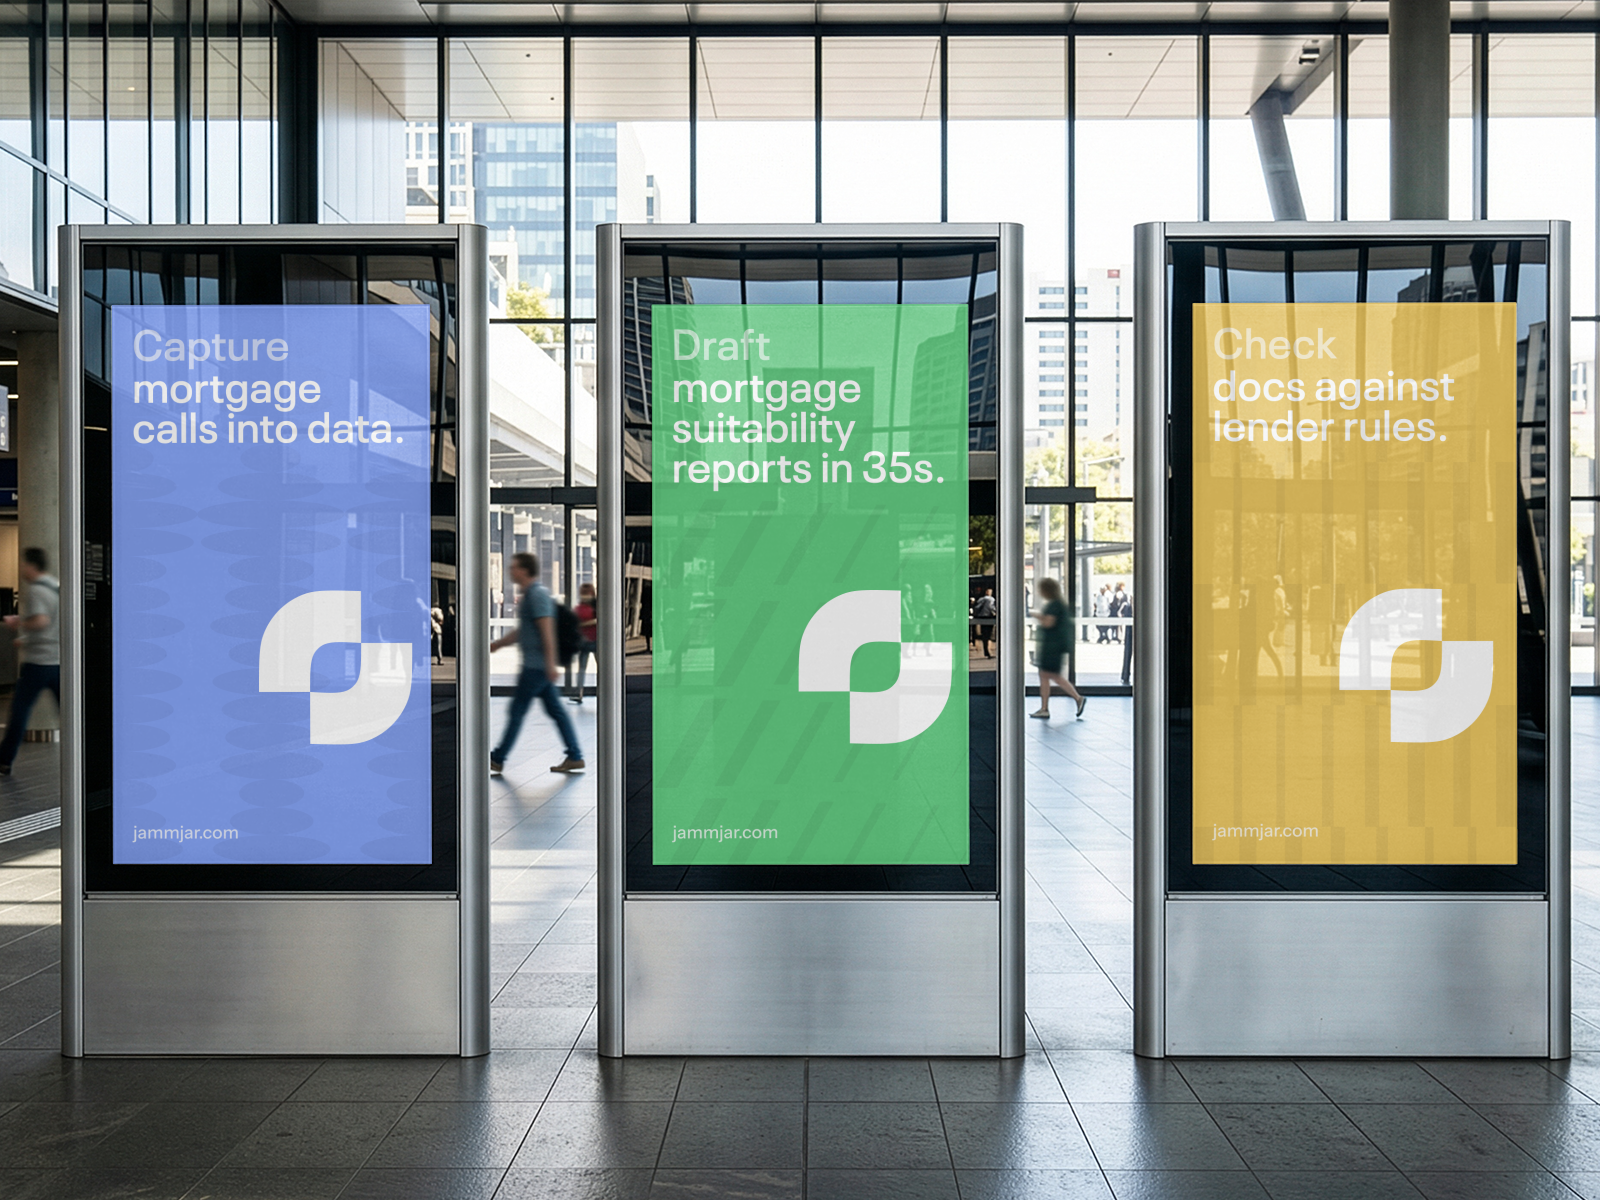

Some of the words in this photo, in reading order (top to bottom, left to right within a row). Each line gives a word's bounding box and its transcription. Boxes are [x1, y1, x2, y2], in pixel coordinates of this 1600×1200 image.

[133, 329, 289, 370] Capture
[673, 328, 770, 361] Draft
[1214, 327, 1337, 360] Check
[133, 376, 321, 412] mortgage
[673, 376, 861, 411] mortgage
[1213, 370, 1306, 402] docs
[1315, 370, 1455, 410] against
[133, 412, 218, 444] calls
[228, 413, 298, 444] into
[307, 412, 404, 444] data.
[672, 412, 856, 451] suitability
[1214, 410, 1334, 442] lender
[1344, 410, 1447, 442] rules.
[673, 454, 812, 491] reports
[822, 453, 853, 483] in
[862, 451, 944, 483] 35s.
[132, 825, 239, 843] jammjar.com
[671, 825, 778, 843] jammjar.com
[1212, 823, 1319, 841] jammjar.com
